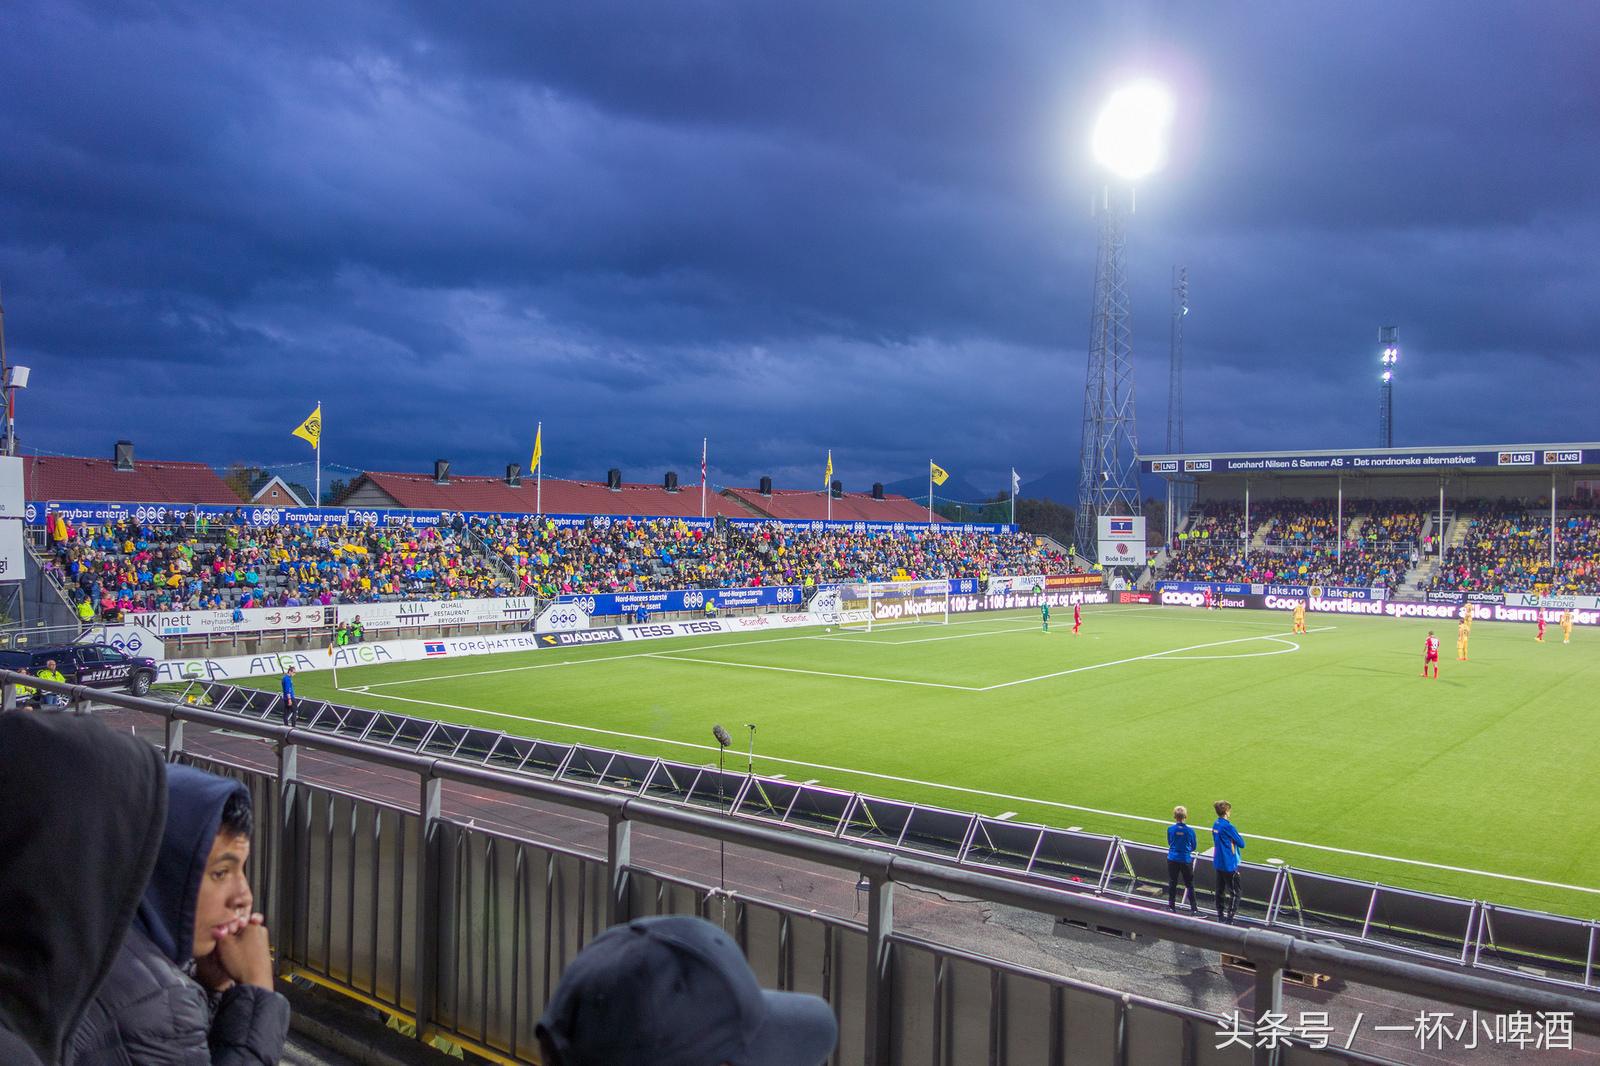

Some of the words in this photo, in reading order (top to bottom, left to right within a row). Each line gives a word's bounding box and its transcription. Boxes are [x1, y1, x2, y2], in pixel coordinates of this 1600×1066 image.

[1227, 460, 1264, 469] Leonhard
[1265, 460, 1290, 468] Nilsen
[1291, 460, 1298, 468] &
[1330, 458, 1343, 467] AS
[1353, 458, 1370, 466] Det
[1371, 456, 1421, 465] nordnorske
[1422, 455, 1476, 465] alternativet
[1513, 454, 1531, 462] LNS
[1559, 453, 1578, 461] LNS
[96, 509, 128, 521] energi
[286, 512, 322, 525] Fornybar
[323, 514, 349, 526] energi
[417, 516, 440, 527] energi
[1120, 556, 1136, 564] Energi
[1268, 586, 1304, 596] laks.no
[1327, 588, 1365, 598] laks.no
[1428, 591, 1462, 601] mpDesign
[950, 596, 966, 611] 100
[967, 597, 978, 610] år
[989, 595, 1004, 609] 100
[1005, 595, 1015, 608] år
[1015, 594, 1028, 607] har
[1029, 593, 1037, 606] vi
[1059, 595, 1069, 607] og
[1162, 592, 1205, 607] coop
[1467, 593, 1504, 602] mpDesign
[400, 603, 425, 614] KAIA
[505, 599, 527, 609] KAIA
[1309, 597, 1383, 614] Nordland
[1385, 603, 1456, 618] sponser
[1541, 600, 1575, 608] BETONG
[434, 609, 470, 618] RESTAURANT
[876, 602, 902, 619] Coop
[739, 616, 769, 627] Scandic
[782, 614, 808, 623] Scandic
[628, 624, 674, 638] TESS
[679, 620, 722, 634] TESS
[560, 630, 619, 644] DIADORA
[450, 637, 534, 652] TORGHATTEN
[92, 667, 131, 681] HILUX
